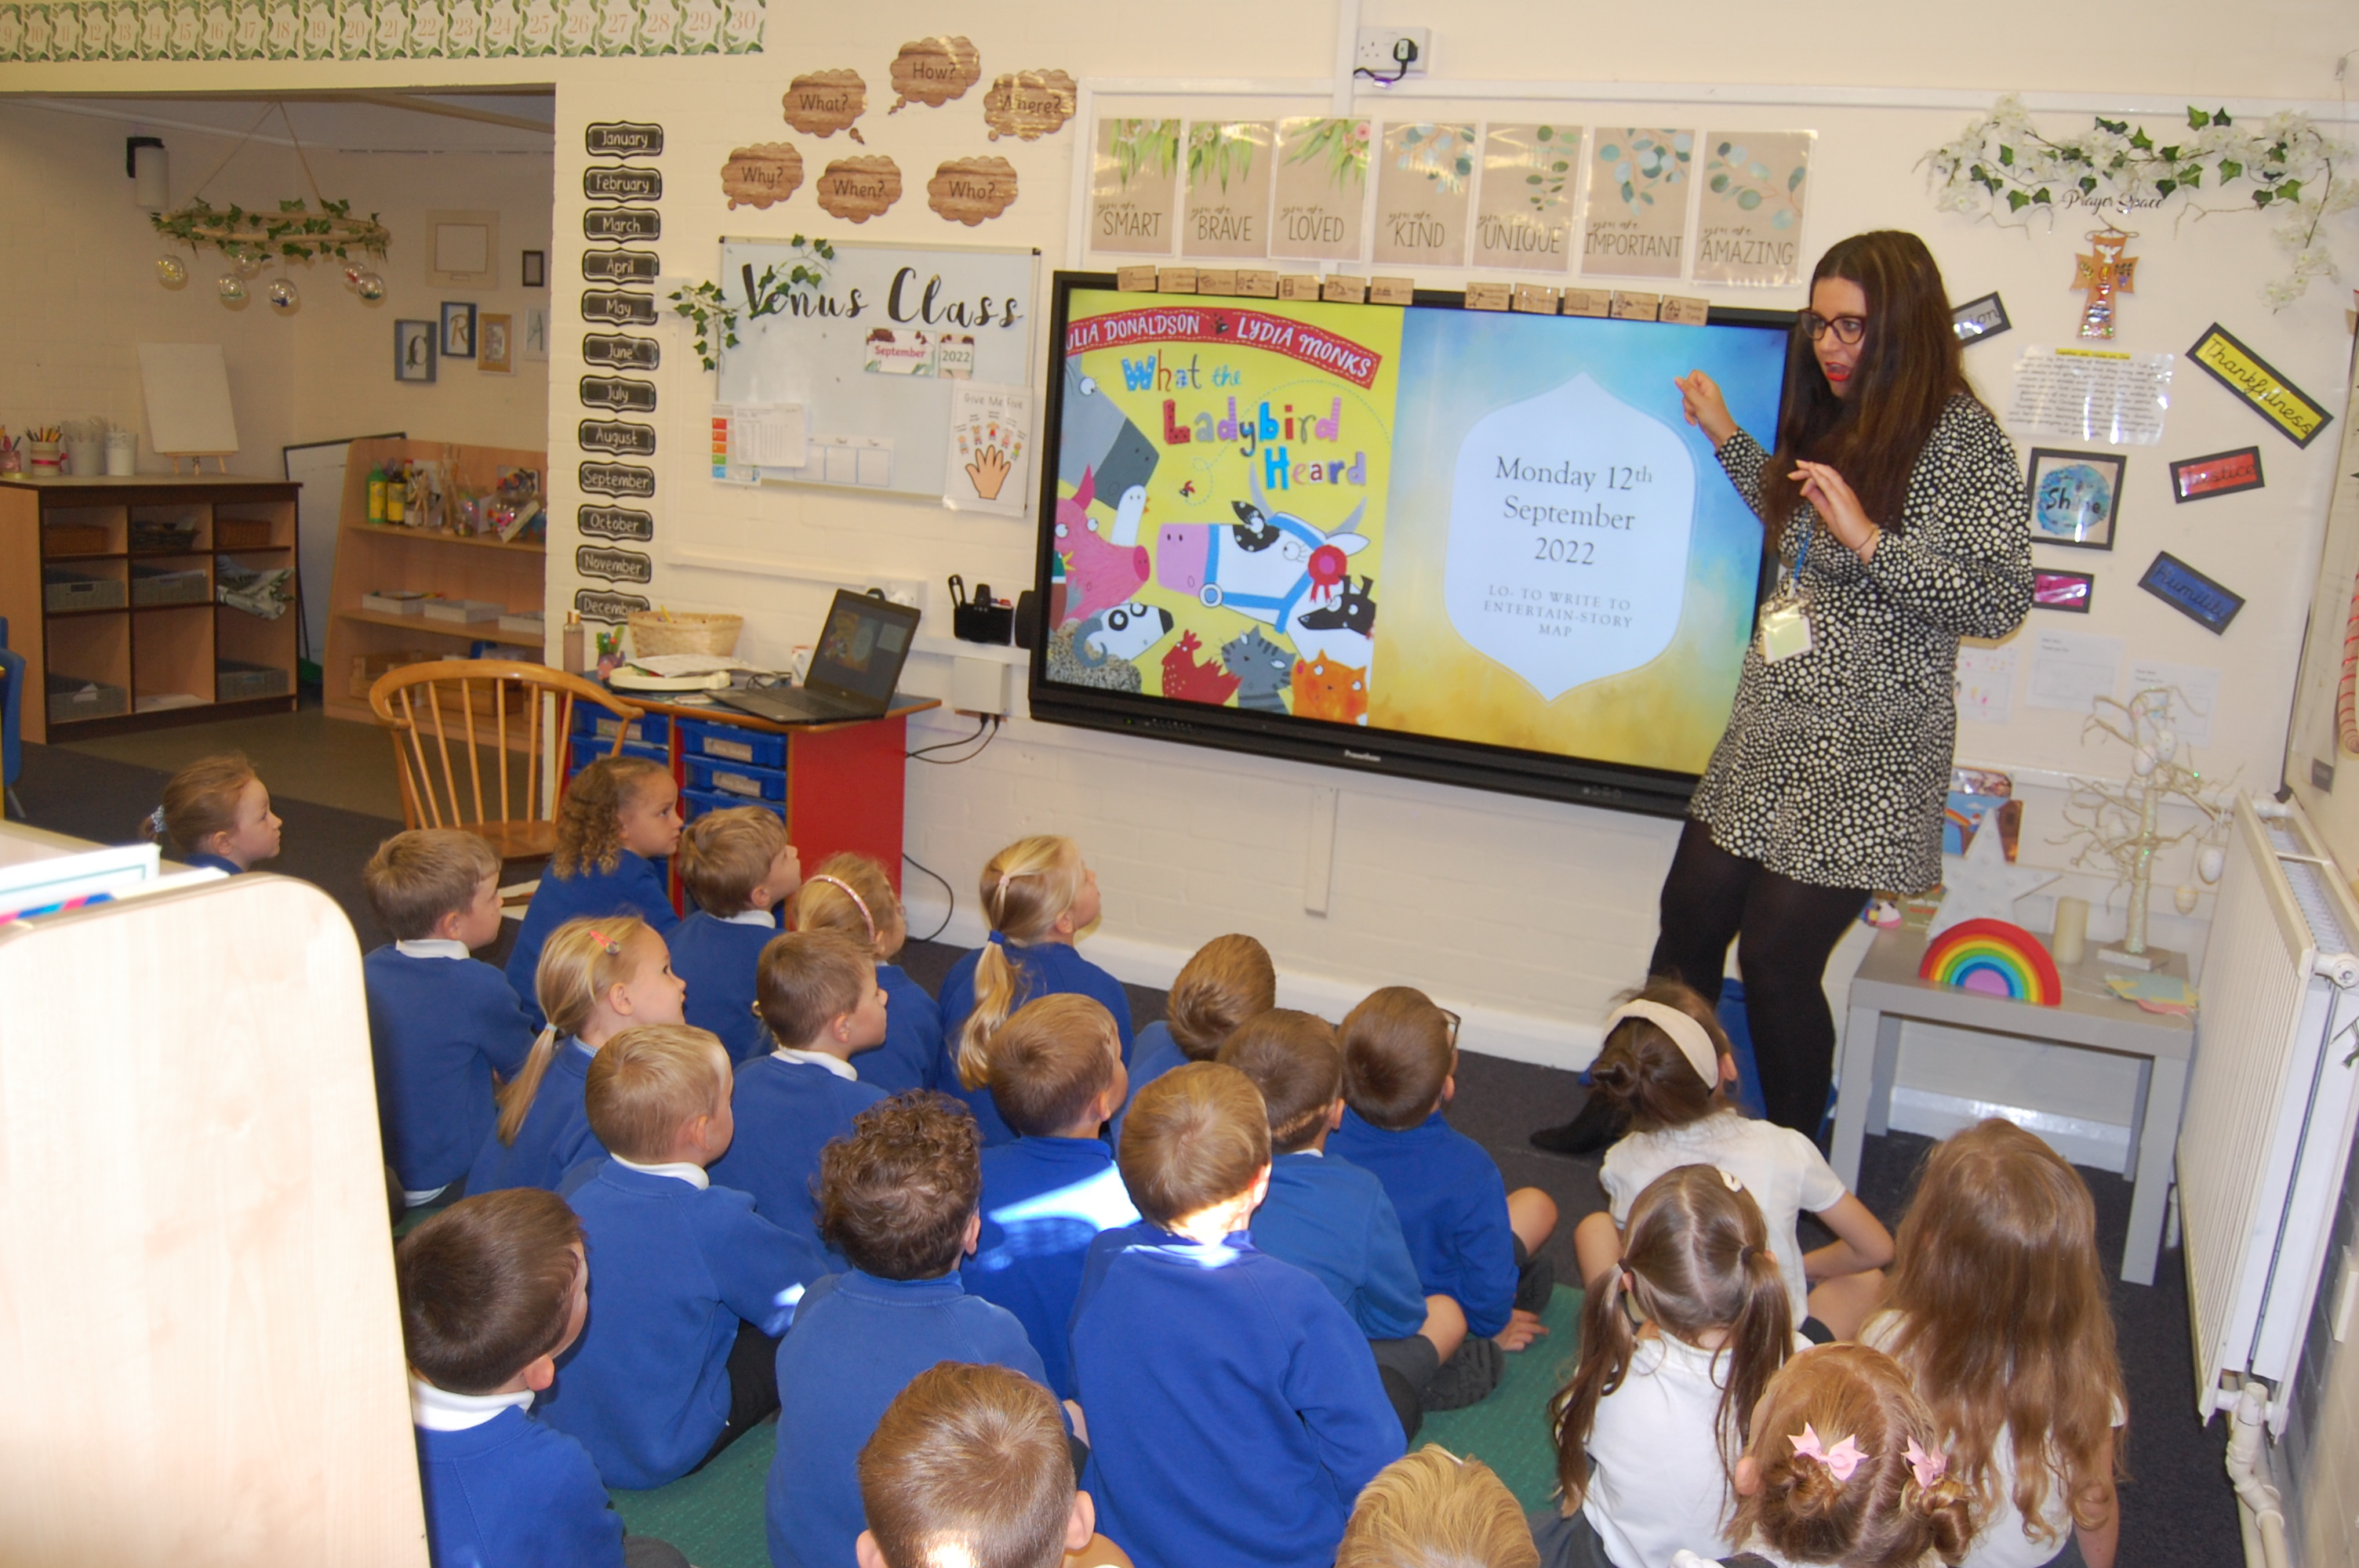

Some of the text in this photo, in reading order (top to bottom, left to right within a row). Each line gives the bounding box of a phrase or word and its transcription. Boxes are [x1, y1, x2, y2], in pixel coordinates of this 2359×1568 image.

[4, 10, 755, 42] 9 10 11 12 13 14 15 16 17 18 19 20 21 22 23 24 25 26 27 28 29 30
[912, 61, 957, 81] How?
[799, 94, 849, 111] What?
[602, 130, 649, 147] January
[596, 174, 649, 194] February
[742, 166, 783, 189] Why?
[833, 180, 885, 198] When?
[949, 180, 996, 200] Who?
[2062, 189, 2164, 216] Prayer Space
[603, 217, 641, 233] March
[1103, 211, 1162, 237] SMART
[1198, 215, 1253, 241] BRAVE
[1289, 215, 1344, 242] LOVED
[1394, 220, 1446, 249] KIND
[1484, 223, 1562, 253] UNIQUE
[1584, 232, 1684, 257] IMPORTANT
[1701, 240, 1794, 265] AMAZING
[607, 258, 634, 275] April
[742, 263, 1024, 328] Venus Class
[606, 300, 631, 317] May
[1103, 314, 1200, 340] DONALDSON
[609, 343, 633, 360] June
[874, 345, 925, 361] September
[942, 350, 970, 363] 2022
[1121, 349, 1241, 391] What the
[607, 385, 629, 403] July
[2205, 337, 2314, 434] Thankfulness
[965, 393, 1023, 408] Give Me Five
[1163, 396, 1341, 456] Ladybird
[595, 428, 638, 448] August
[1264, 446, 1366, 490] Heard
[1496, 456, 1652, 492] Monday 12th
[584, 470, 649, 490] September
[591, 513, 638, 532] October
[1503, 495, 1636, 530] September
[1535, 537, 1594, 565] 2022
[585, 554, 642, 575] November
[1521, 588, 1543, 601] TO
[1550, 591, 1601, 608] WRITE
[1609, 597, 1630, 612] TO
[1484, 601, 1634, 628] ENTERTAIN-STORY
[1539, 623, 1572, 637] MAP
